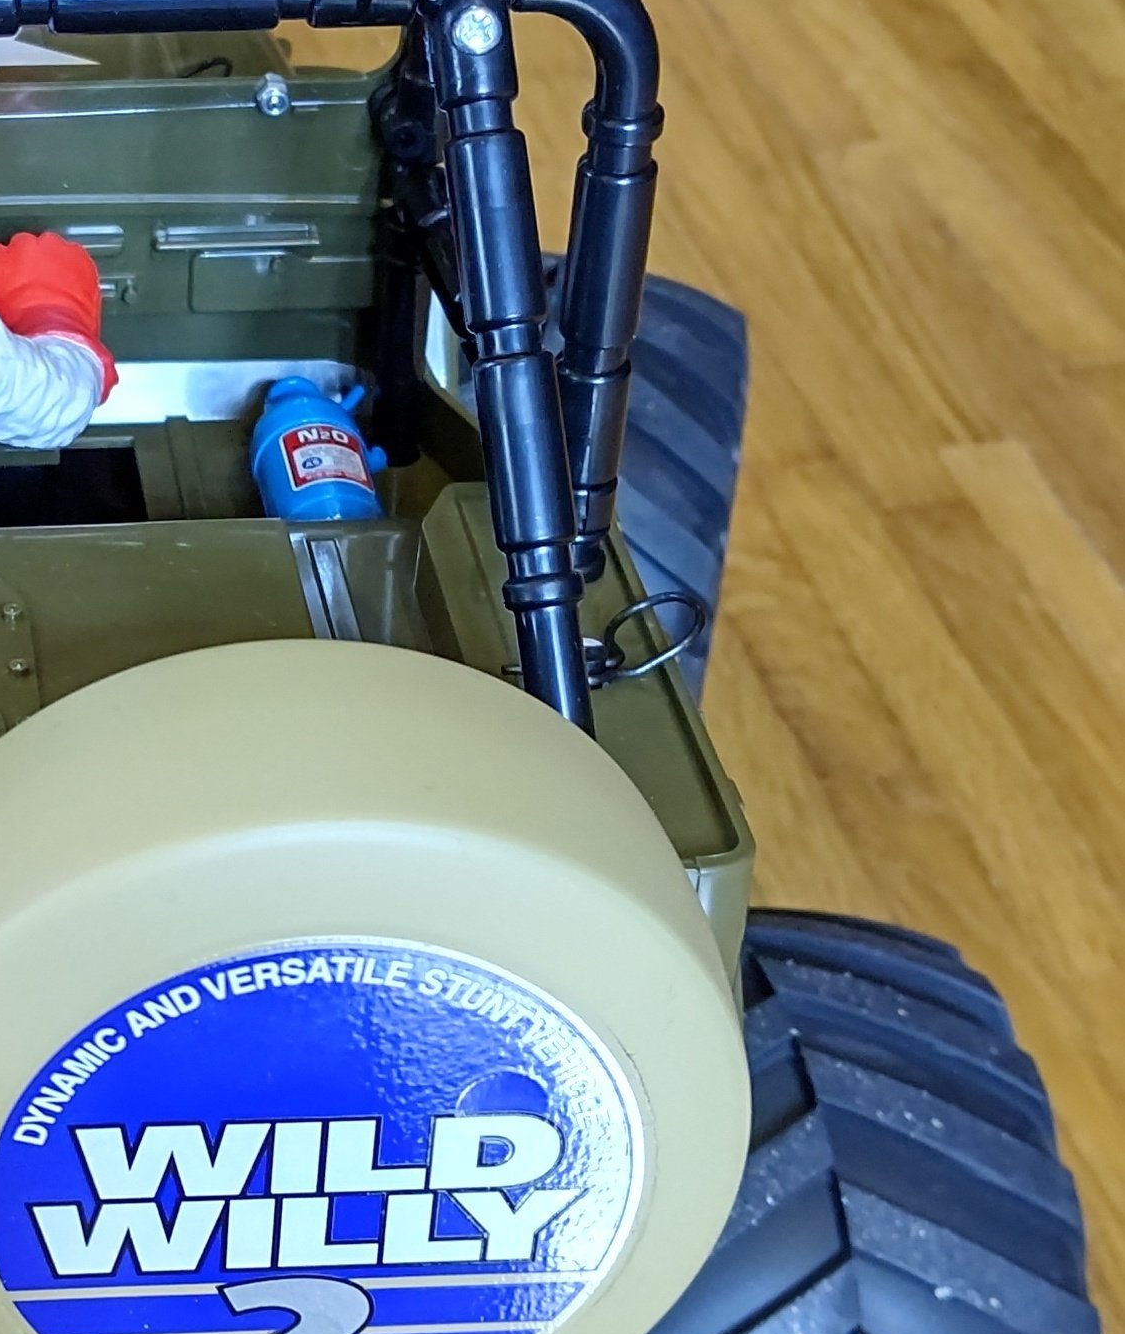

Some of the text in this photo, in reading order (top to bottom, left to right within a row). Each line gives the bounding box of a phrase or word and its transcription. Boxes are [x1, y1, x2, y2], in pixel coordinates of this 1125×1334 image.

[297, 428, 349, 444] N2O
[13, 955, 612, 1146] DYNAMIC AND VERSATILE STUNT VEHICLE
[70, 1113, 566, 1199] WILD
[27, 1188, 589, 1278] WILLY
